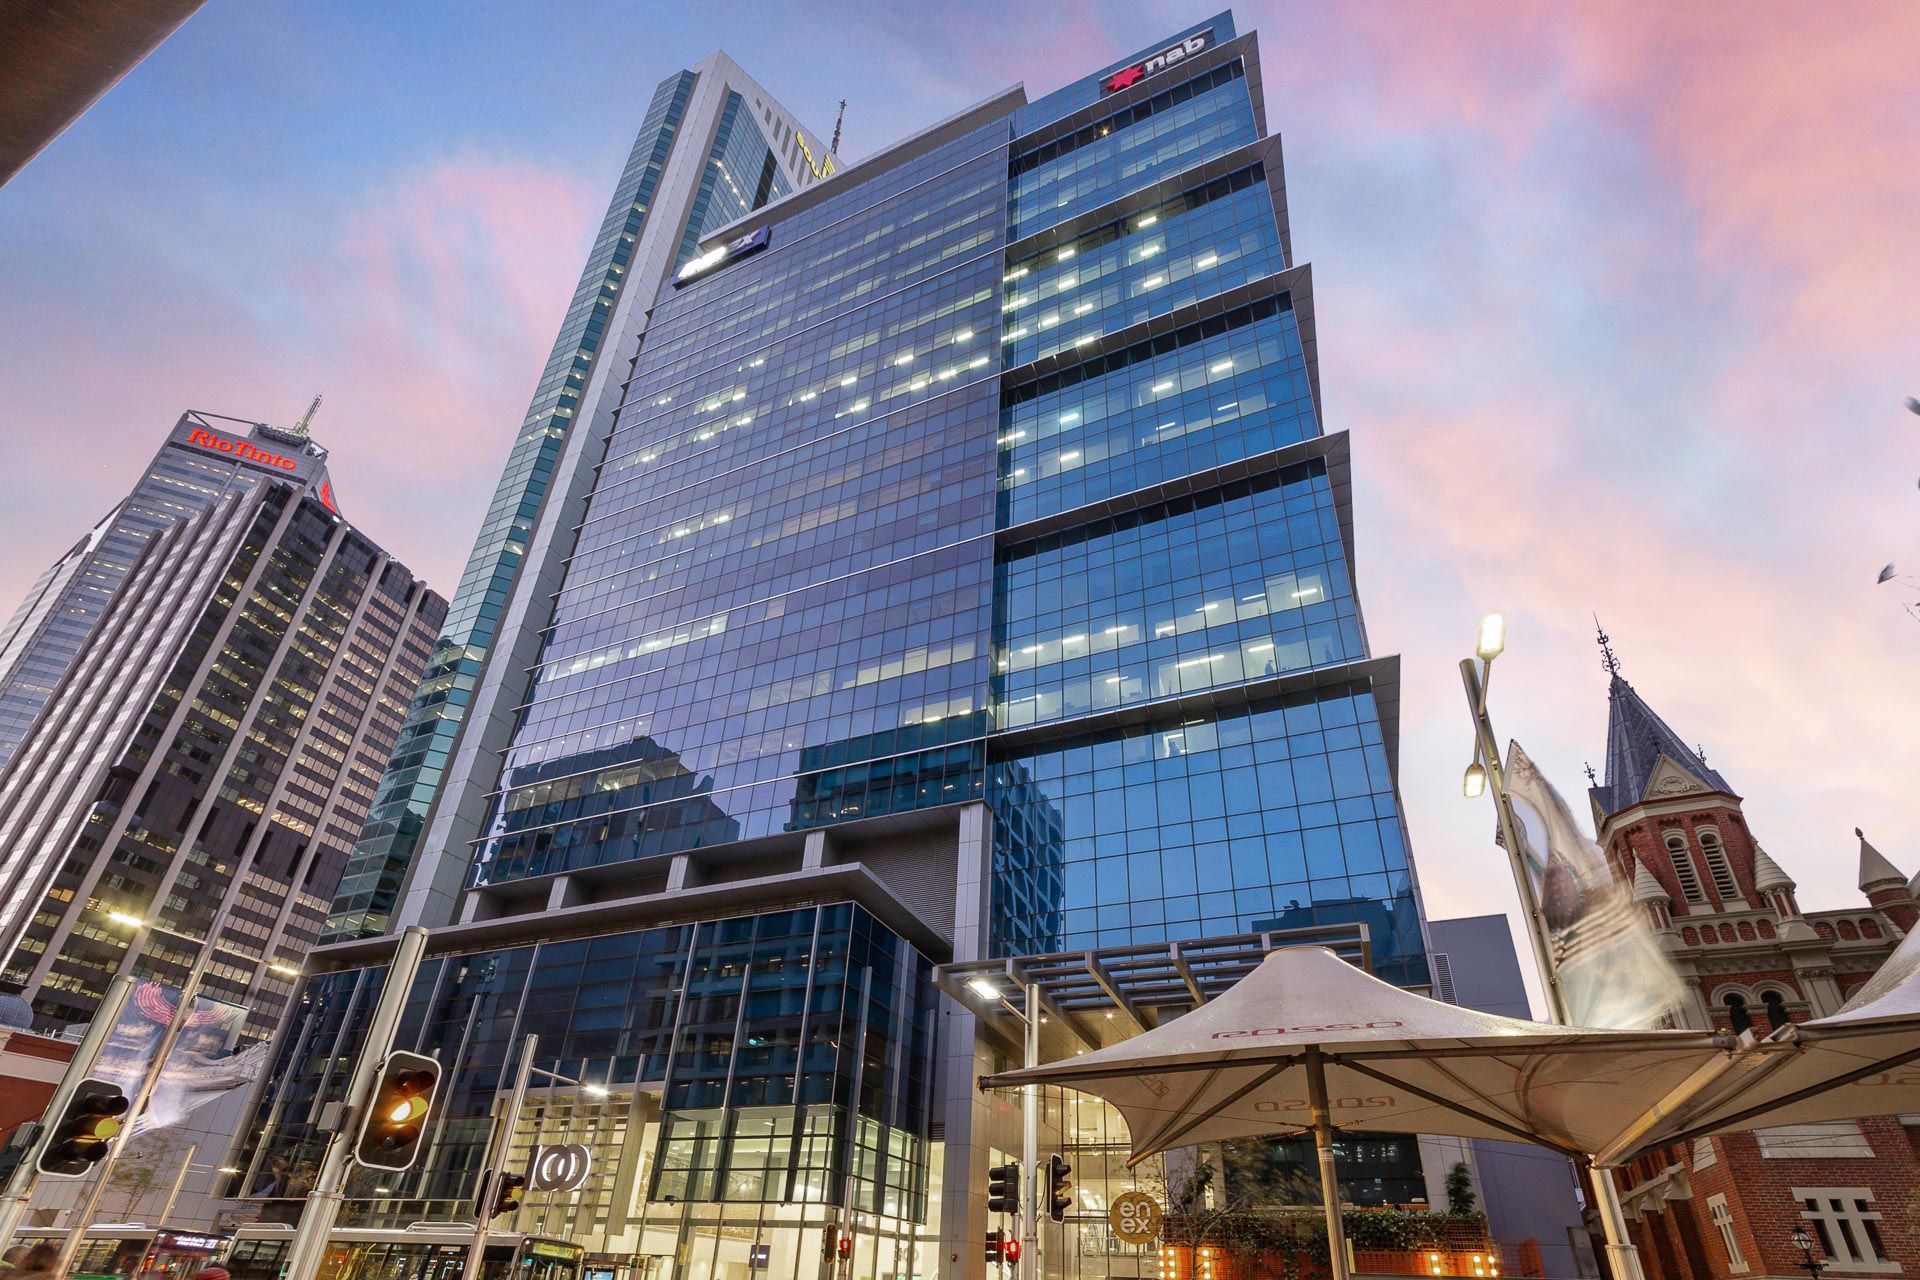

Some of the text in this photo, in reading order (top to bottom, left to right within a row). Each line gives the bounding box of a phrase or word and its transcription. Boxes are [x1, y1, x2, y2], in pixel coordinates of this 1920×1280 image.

[1145, 38, 1206, 74] nab
[523, 1144, 592, 1192] 100
[1120, 1201, 1151, 1218] en
[1120, 1217, 1152, 1234] ex
